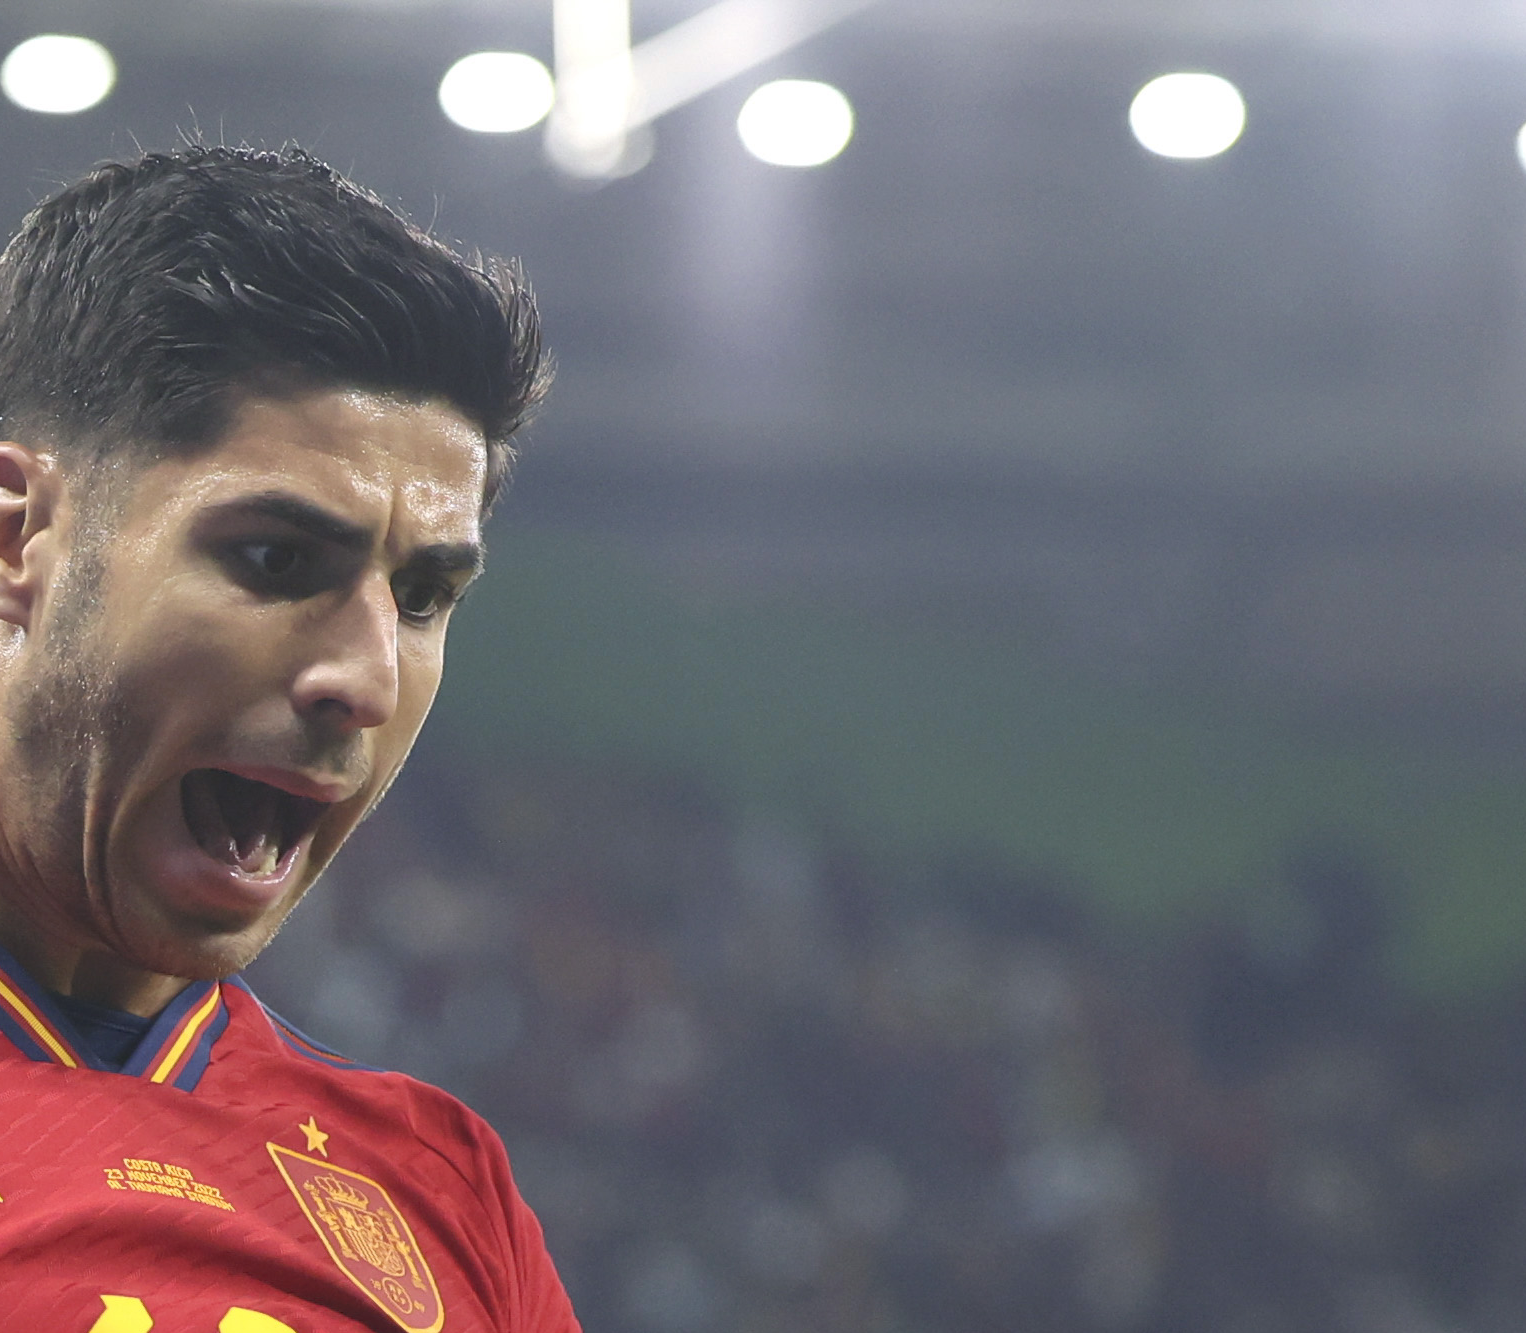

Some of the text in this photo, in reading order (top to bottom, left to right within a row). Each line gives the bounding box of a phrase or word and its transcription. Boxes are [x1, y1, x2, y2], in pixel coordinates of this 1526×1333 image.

[123, 1158, 193, 1180] COSTA RICA
[104, 1169, 224, 1199] 23 NOVEMBER 2022
